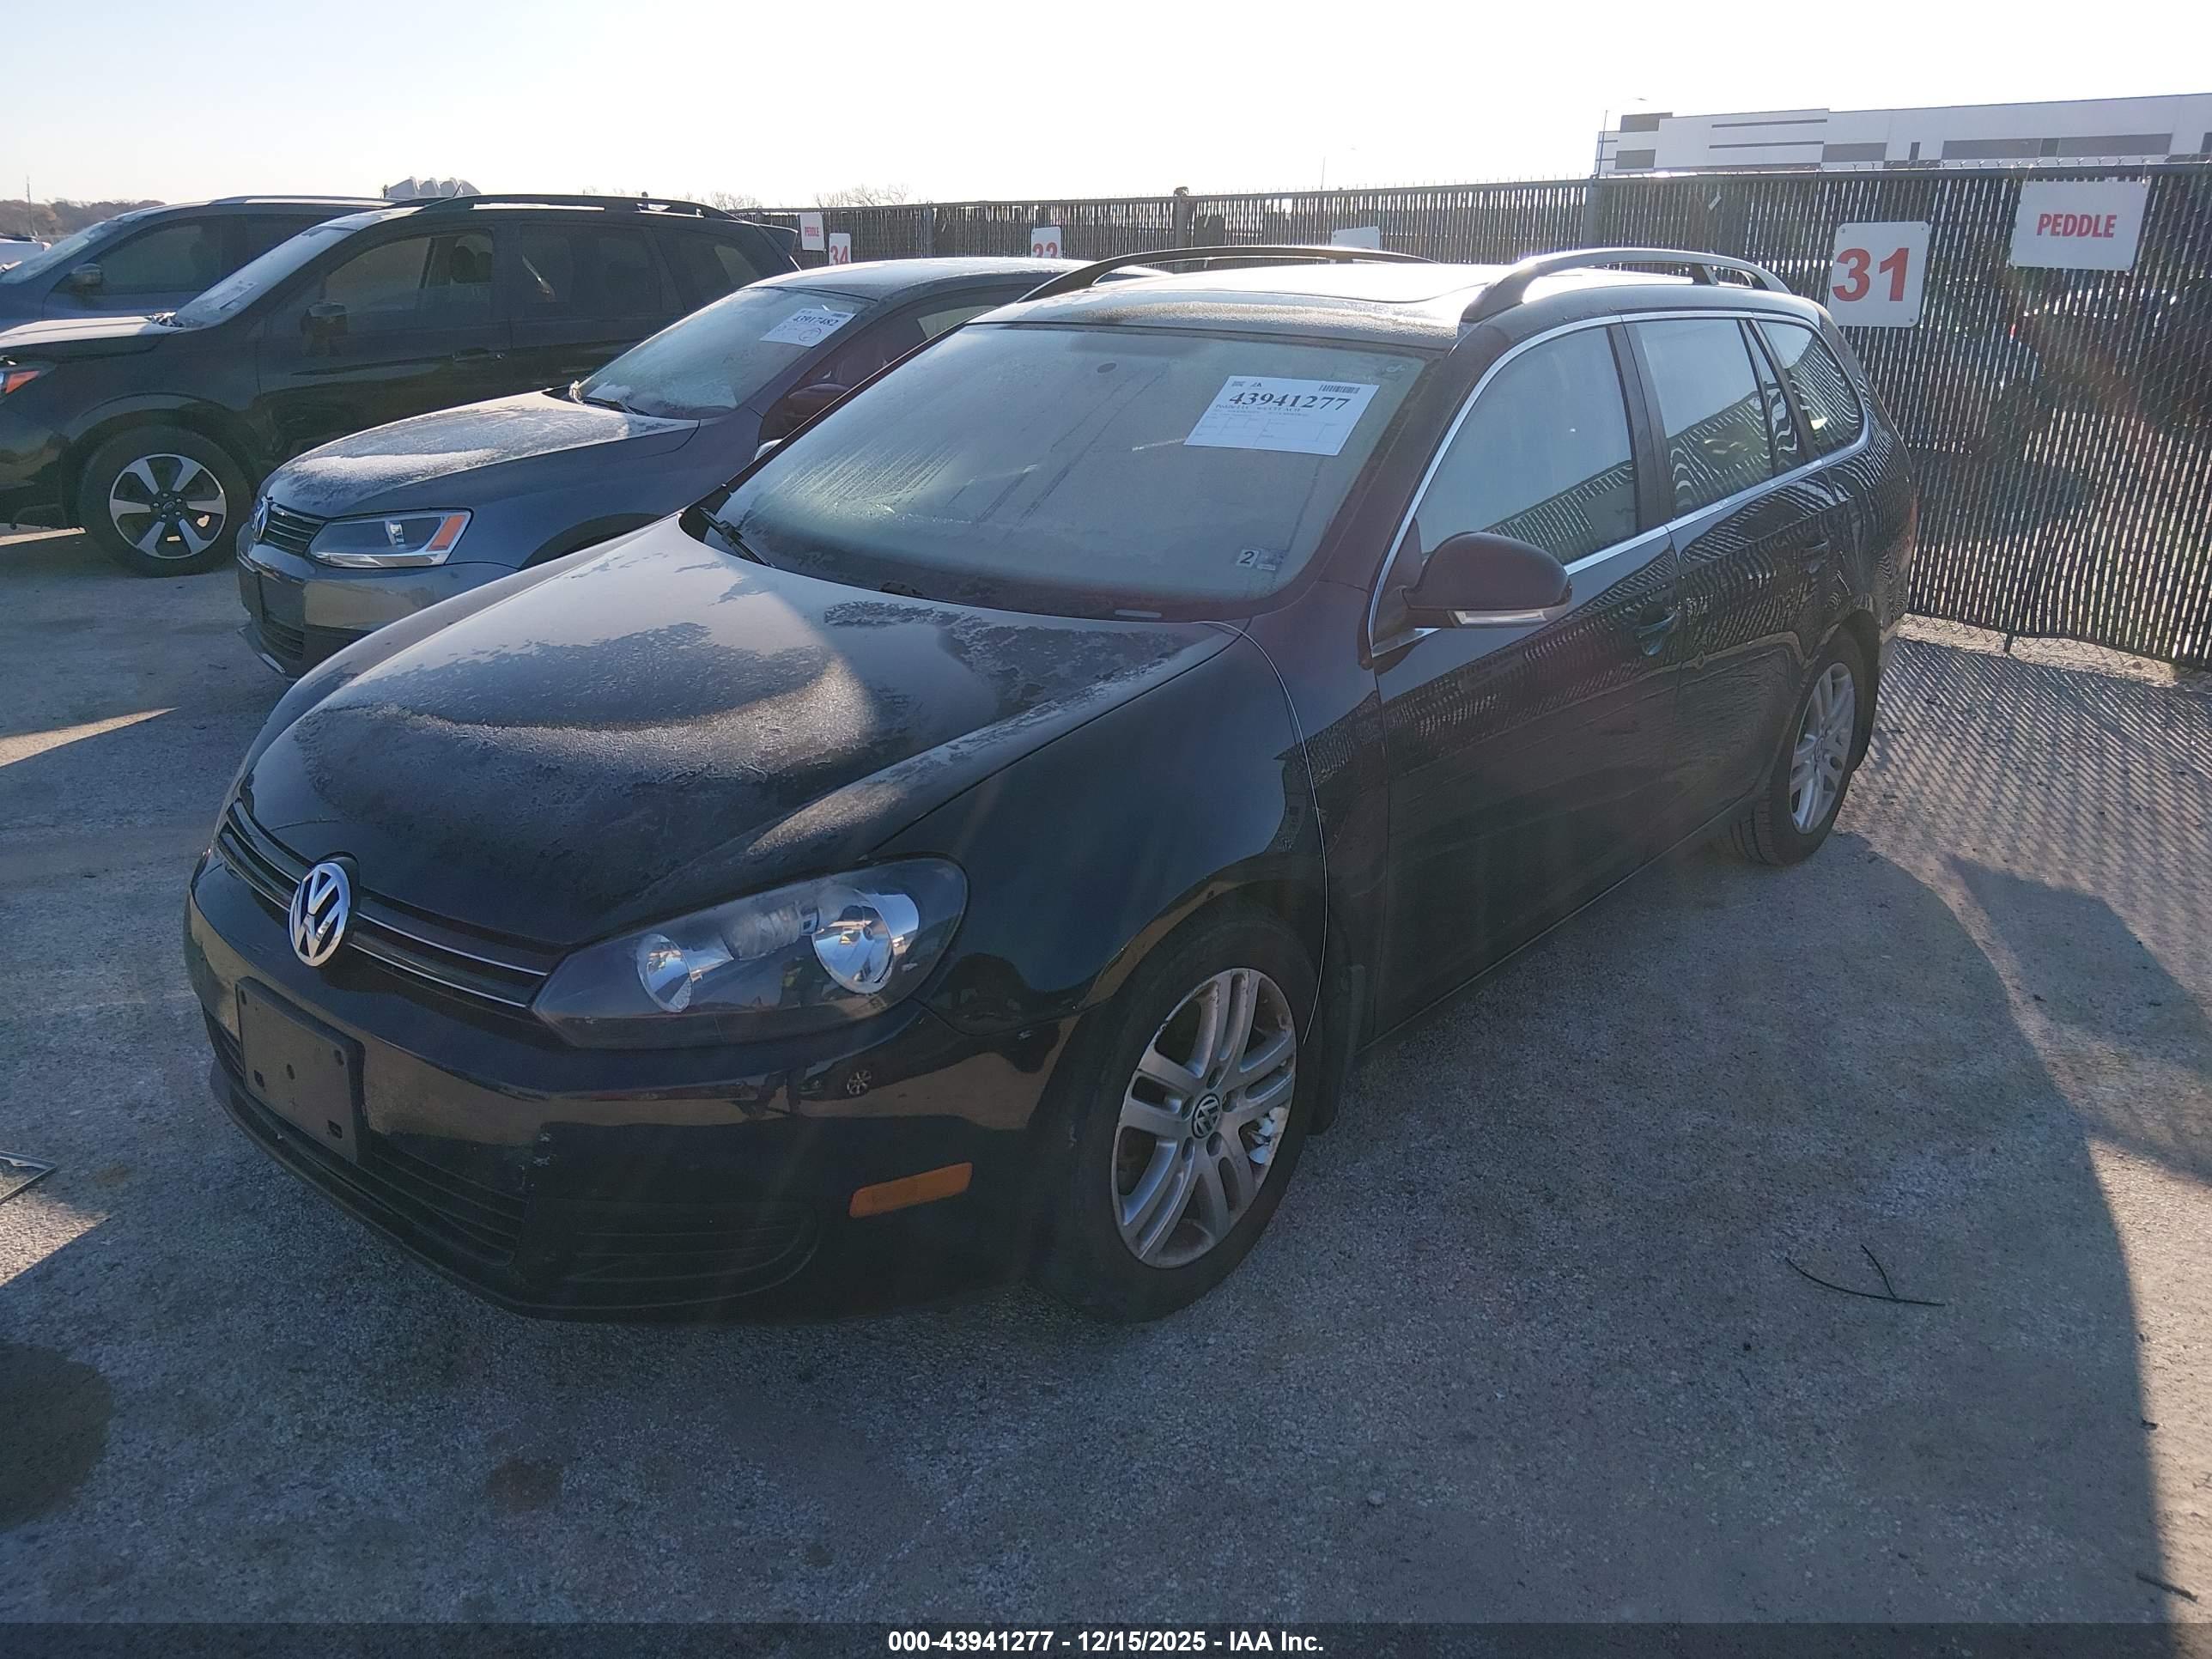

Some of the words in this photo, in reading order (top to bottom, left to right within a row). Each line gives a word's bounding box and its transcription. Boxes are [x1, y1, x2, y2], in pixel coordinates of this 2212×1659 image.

[2037, 213, 2118, 238] PEDDLE
[1832, 247, 1910, 302] 31
[1229, 392, 1352, 410] 43941277
[1239, 550, 1255, 564] 2
